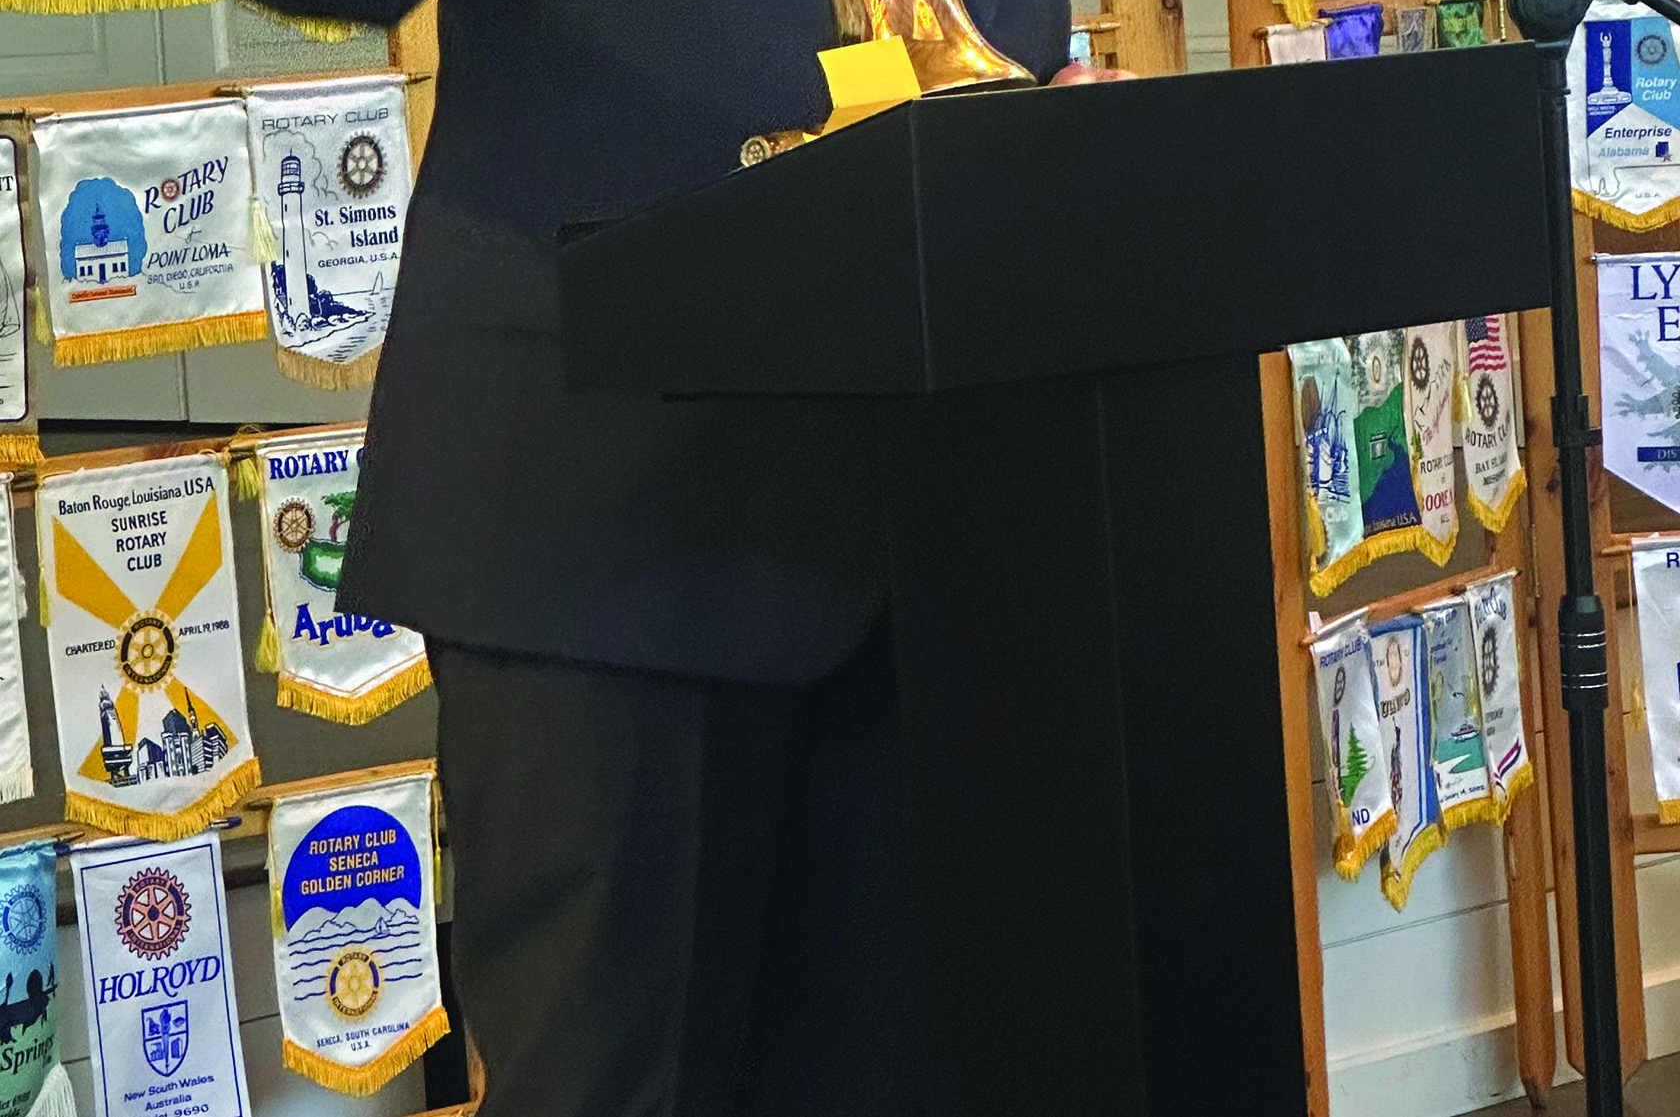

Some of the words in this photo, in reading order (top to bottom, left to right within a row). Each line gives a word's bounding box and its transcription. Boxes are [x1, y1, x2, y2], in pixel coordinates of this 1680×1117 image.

[1636, 77, 1677, 91] Rotary
[1642, 90, 1672, 102] Club
[262, 112, 338, 131] ROTARY
[345, 107, 390, 124] CLUB
[1605, 127, 1672, 140] Enterprise
[1598, 143, 1650, 158] Alabama
[163, 190, 215, 234] CLUB
[314, 209, 334, 227] St.
[340, 204, 397, 224] Simons
[350, 226, 399, 248] Island
[148, 246, 188, 269] POINT
[191, 243, 230, 263] LOMA
[148, 273, 164, 285] SAN
[1465, 427, 1497, 449] ROTARY
[269, 449, 350, 480] ROTARY
[1657, 449, 1680, 461] DIS
[59, 499, 91, 516] Baton
[184, 477, 215, 497] USA
[111, 510, 168, 533] SUNRISE
[1323, 503, 1349, 523] Club
[1396, 511, 1418, 525] USA
[116, 532, 167, 553] ROTARY
[127, 553, 163, 572] CLUB
[179, 626, 203, 636] APRIL
[212, 620, 230, 632] 1988
[65, 639, 115, 657] CHARTERED
[309, 837, 360, 855] ROTARY
[365, 829, 397, 846] CLUB
[329, 853, 379, 872] SENECA
[301, 874, 352, 895] GOLDEN
[356, 865, 405, 885] CORNER
[99, 956, 221, 1005] HOLROYD
[346, 1028, 370, 1041] SOUTH
[372, 1021, 410, 1038] CAROLINA
[124, 1092, 146, 1103] New
[148, 1081, 178, 1096] South
[179, 1074, 215, 1089] Wales
[145, 1093, 192, 1112] Australia
[174, 1103, 209, 1117] 9690
